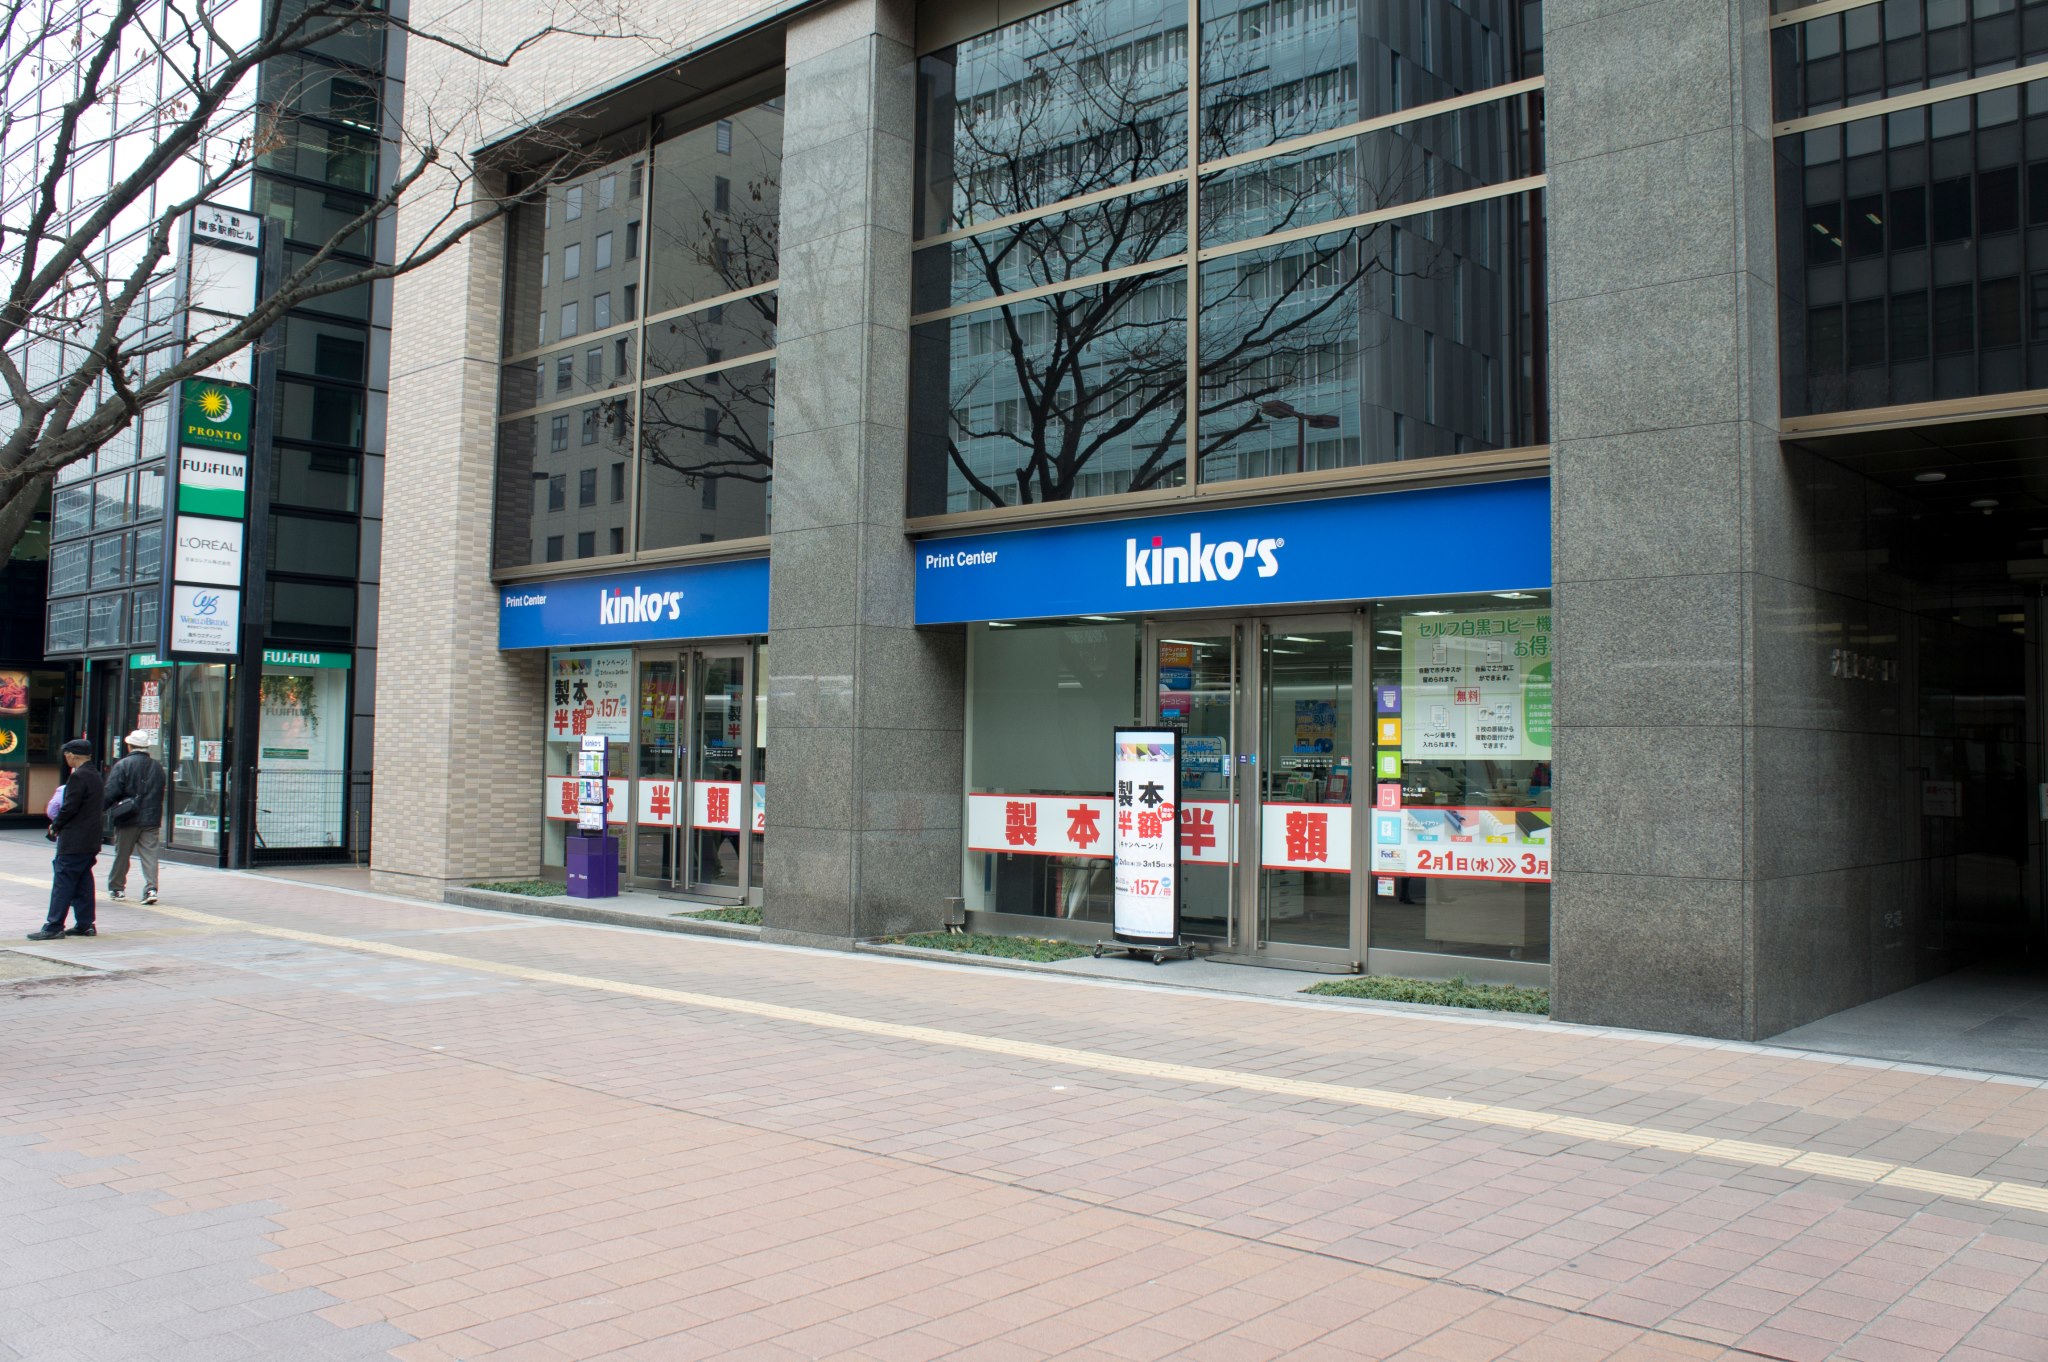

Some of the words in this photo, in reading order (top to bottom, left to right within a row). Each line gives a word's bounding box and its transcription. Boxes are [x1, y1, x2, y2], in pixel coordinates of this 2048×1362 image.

[188, 425, 242, 441] PRONTO
[182, 459, 244, 477] FUJIFILM
[925, 553, 955, 569] Print
[957, 550, 998, 567] Center
[1126, 532, 1280, 587] kinko's
[505, 596, 523, 608] Print
[523, 594, 547, 607] Center
[600, 586, 681, 625] kinko's
[1418, 615, 1552, 638] セルフ白黒コピー機
[263, 651, 321, 665] FUJIFILM
[554, 678, 589, 706] 製本
[1456, 689, 1479, 703] 無料
[650, 785, 671, 820] 半
[707, 786, 729, 824] 額
[1118, 780, 1164, 808] 製本
[1118, 810, 1163, 838] 半額
[1180, 807, 1216, 856] 半
[1285, 811, 1328, 863] 額
[1380, 850, 1401, 859] FedEx
